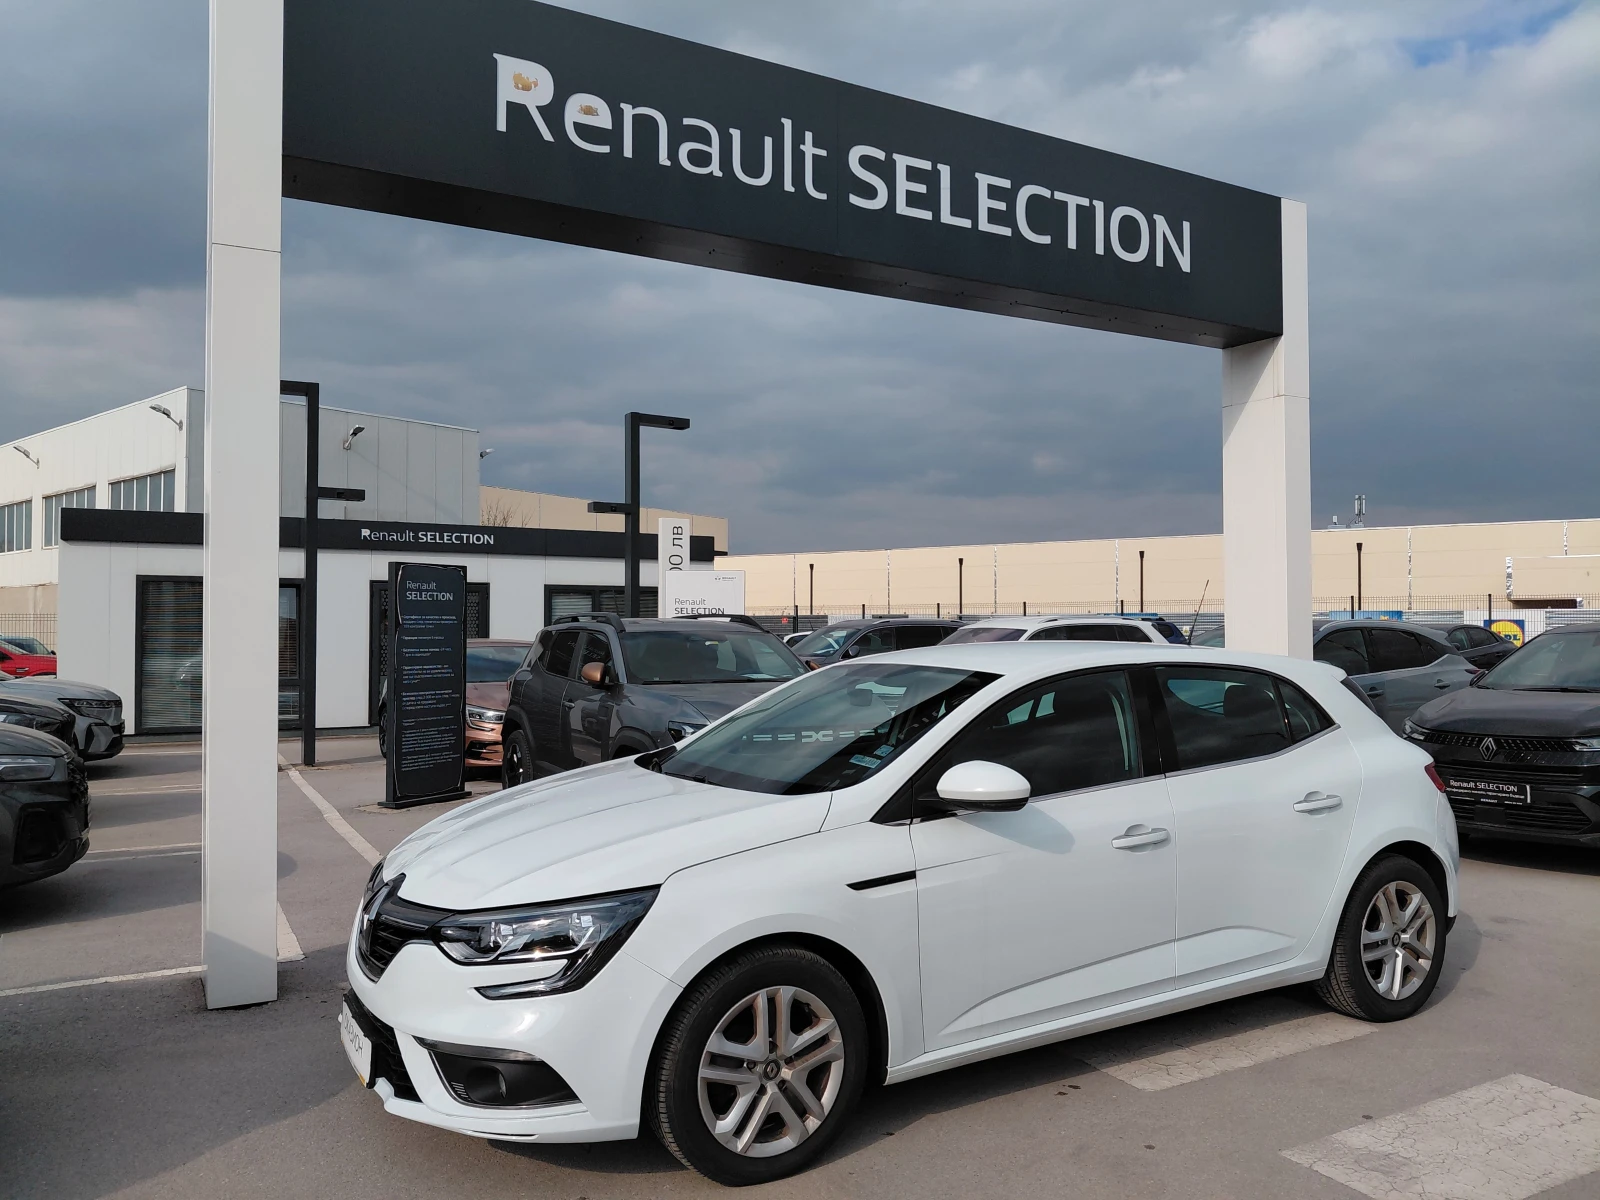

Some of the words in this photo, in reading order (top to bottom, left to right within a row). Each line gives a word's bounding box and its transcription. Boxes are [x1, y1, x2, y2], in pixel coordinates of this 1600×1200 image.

[492, 53, 828, 201] Renault
[848, 144, 1192, 273] SELECTION
[360, 528, 415, 542] Renault
[418, 531, 494, 545] SELECTION
[668, 554, 684, 571] 0
[406, 580, 437, 590] Renault
[406, 591, 454, 601] SELECTION
[674, 598, 707, 606] Renault
[674, 607, 725, 615] SELECTION
[1449, 779, 1475, 789] Renault
[1477, 782, 1518, 793] SELECTION
